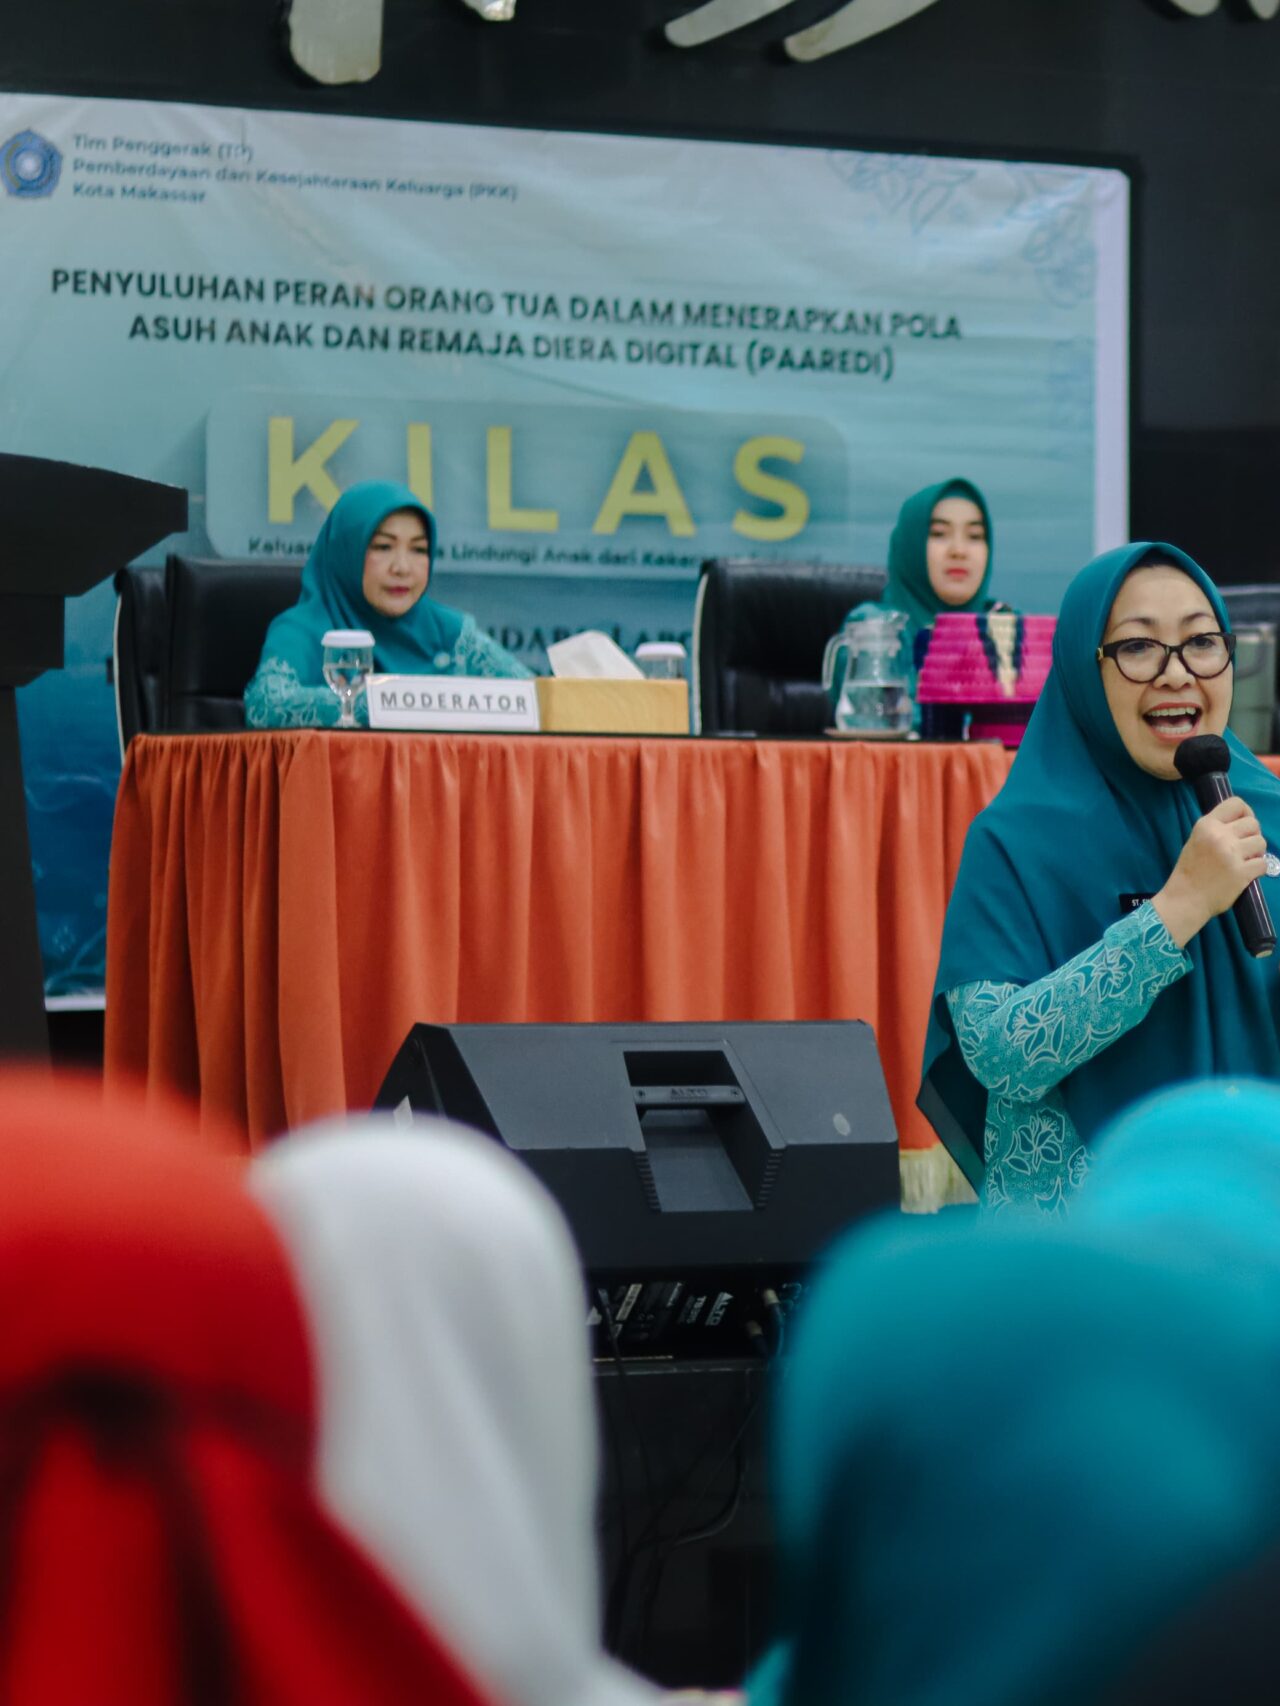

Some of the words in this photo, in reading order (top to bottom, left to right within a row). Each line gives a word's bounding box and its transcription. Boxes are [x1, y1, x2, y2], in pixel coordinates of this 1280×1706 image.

[74, 134, 107, 150] Tim
[112, 136, 211, 157] Penggerak
[73, 157, 210, 181] Pemberdayaan
[216, 166, 250, 182] dan
[256, 168, 379, 189] Kesejahteraan
[386, 177, 463, 200] Keluarga
[469, 182, 518, 202] (PKK)
[73, 182, 114, 198] Kota
[121, 183, 206, 202] Makassar
[51, 269, 265, 302] PENYULUHAN
[273, 279, 375, 308] PERAN
[384, 286, 494, 315] ORANG
[502, 292, 560, 318] TUA
[571, 297, 674, 325] DALAM
[684, 302, 882, 336] MENERAPKAN
[890, 312, 963, 340] POLA
[128, 314, 216, 342] ASUH
[225, 319, 313, 347] ANAK
[322, 324, 389, 351] DAN
[400, 327, 524, 357] REMAJA
[533, 334, 617, 362] DIERA
[626, 339, 738, 369] DIGITAL
[745, 339, 895, 382] (PAAREDI)
[268, 416, 811, 541] KILAS
[451, 544, 537, 566] Lindungi
[543, 548, 591, 563] Anak
[598, 548, 637, 566] dari
[380, 691, 528, 713] MODERATOR
